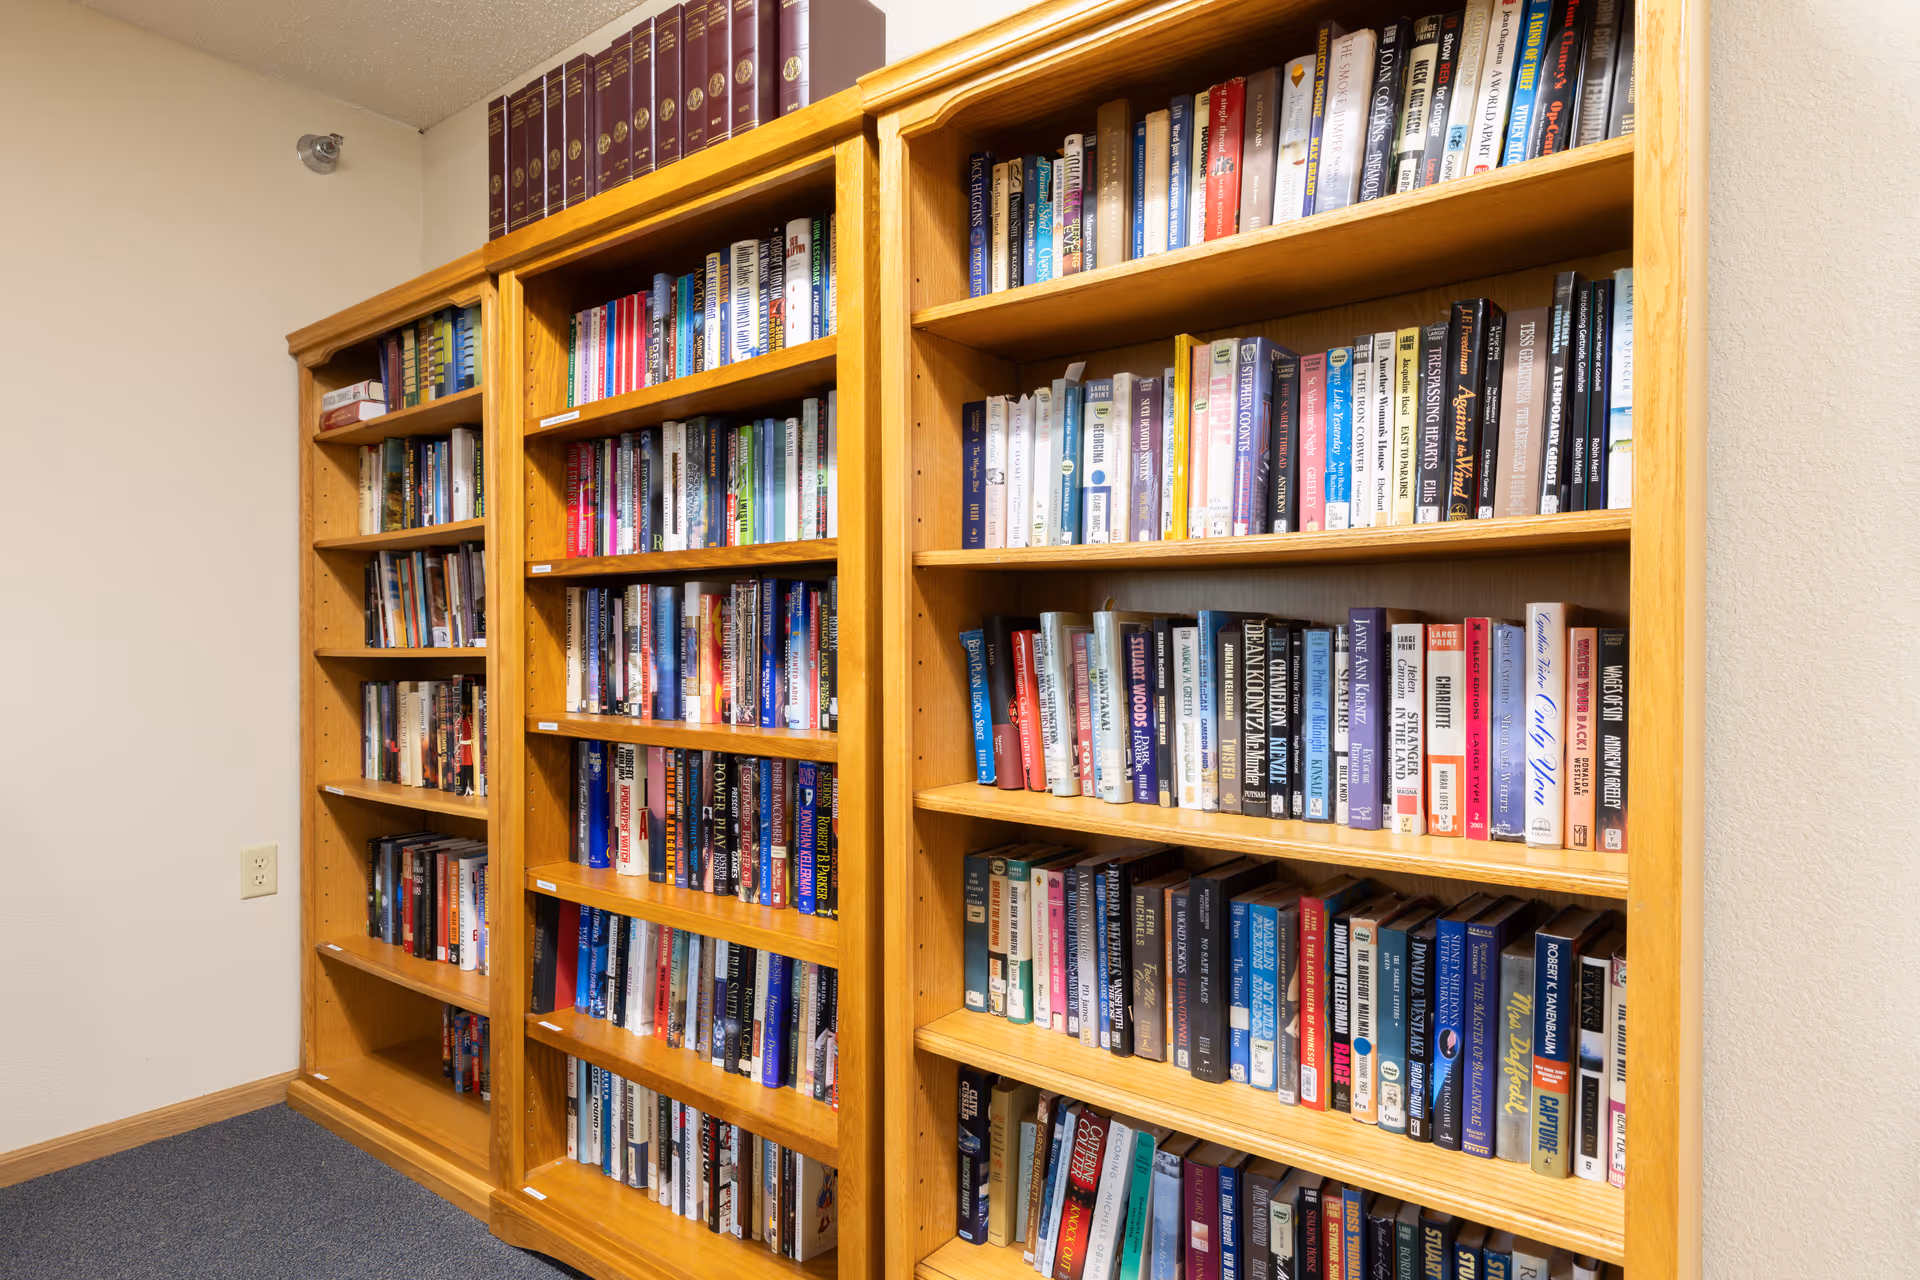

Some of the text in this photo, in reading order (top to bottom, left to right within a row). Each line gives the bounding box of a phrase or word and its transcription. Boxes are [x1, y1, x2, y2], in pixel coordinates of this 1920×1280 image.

[1495, 10, 1511, 64] Jean Chapman
[1525, 48, 1539, 61] OF
[1526, 22, 1543, 46] KIND
[1406, 60, 1429, 136] NECK AND NECK
[1430, 34, 1454, 137] show RED for danger
[1485, 78, 1501, 121] WORLD
[1519, 63, 1537, 90] THIEF
[1306, 137, 1319, 195] MAX BRAND
[1479, 123, 1492, 158] APART
[971, 157, 984, 226] JACK HIGGINS
[813, 220, 821, 286] JOHN LESCROART
[693, 268, 703, 310] AMY TAN
[706, 256, 717, 320] FAYE KELLERMAN
[1579, 291, 1587, 328] Introducing
[1578, 329, 1586, 360] Gertrude,
[1239, 366, 1252, 451] STEPHEN COONTS
[1306, 377, 1316, 456] St. Valentine's Night
[1332, 389, 1343, 454] Like Yesterday
[1356, 370, 1366, 472] THE IRON COBWEB
[1377, 356, 1388, 470] Another Woman's House
[1424, 347, 1441, 469] TRESPASSING HEARTS
[1550, 375, 1562, 445] TEMPORARY
[1093, 423, 1104, 463] GEORGINA
[1399, 426, 1409, 499] EAST TO PARADISE
[1453, 385, 1476, 498] Against the Wind
[1547, 447, 1558, 485] GHOST
[1574, 438, 1583, 484] Robin Merrill
[1277, 475, 1286, 513] ANTHONY
[1306, 467, 1316, 508] GREELEY
[1377, 478, 1385, 511] Eberhart
[1423, 480, 1435, 502] Ellis
[1098, 668, 1110, 730] MONTANA!
[1131, 637, 1147, 727] STUART WOODS
[1225, 643, 1234, 720] JONATHAN KELLERMAN
[1245, 623, 1264, 731] DEAN KOONTZ
[1270, 659, 1286, 726] CHAMELEON
[1309, 649, 1326, 752] The Prince of Midnight
[1354, 620, 1369, 724] JAYNE ANN KRENTZ
[1397, 659, 1406, 699] Cannam
[1408, 665, 1417, 693] Helen
[1435, 676, 1451, 728] CHARLOTTE
[1576, 639, 1589, 750] WATCH YOUR BACK!
[1604, 666, 1622, 721] WAGES OF SIN
[625, 749, 634, 780] ROBERT
[1134, 730, 1143, 771] HARBOR
[1141, 736, 1150, 765] DARK
[1222, 739, 1236, 779] TWISTED
[1270, 737, 1286, 784] KIENZLE
[1396, 708, 1405, 780] IN THE LAND
[1408, 712, 1418, 775] STRANGER
[1528, 694, 1557, 806] Only You
[621, 785, 630, 863] APOCALYPSE WATCH
[714, 763, 726, 849] POWER PLAY
[772, 762, 784, 844] DEBBIE MACOMBER
[800, 807, 812, 896] JONATHAN KELLERMAN
[817, 816, 830, 900] ROBERT B. PARKER
[1135, 896, 1144, 946] MICHAELS
[1146, 909, 1154, 935] FERN
[1334, 923, 1348, 1033] JONATHAN KELLERMAN
[1358, 949, 1368, 1037] THE BAREFOOT MAILMAN
[1545, 943, 1558, 1054] ROBERT K. TANENBAUM
[765, 995, 778, 1076] House of Dreams
[1334, 1042, 1350, 1085] RAGE
[961, 1081, 969, 1120] CUSSLER
[969, 1089, 977, 1116] CLIVE
[1539, 1095, 1559, 1154] CAPTURE
[1071, 1118, 1090, 1178] COULTER
[1081, 1125, 1103, 1184] CATHERINE
[1060, 1204, 1080, 1271] KNOCK OUT
[1307, 1210, 1316, 1273] STALKING HORSE
